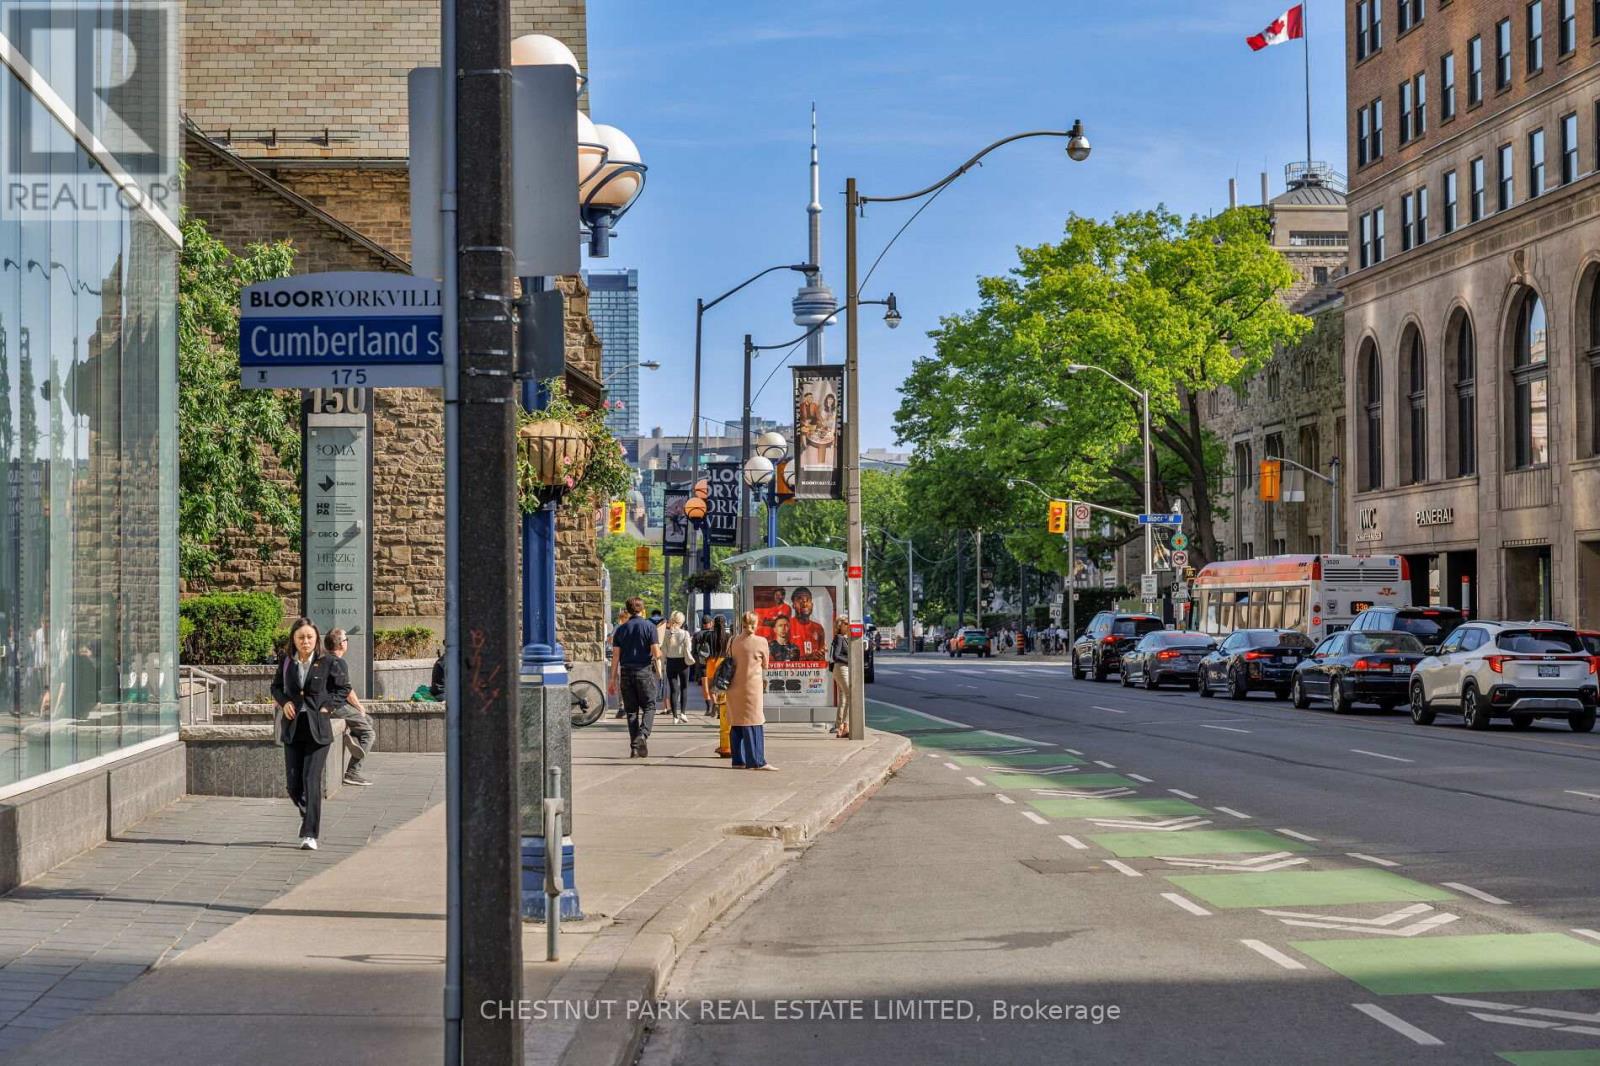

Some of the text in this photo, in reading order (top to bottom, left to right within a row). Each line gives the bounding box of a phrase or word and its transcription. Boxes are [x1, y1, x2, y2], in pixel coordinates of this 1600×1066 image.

[251, 325, 442, 357] Cumberland S
[331, 369, 367, 385] 175
[309, 387, 366, 414] 150
[1360, 507, 1377, 529] IWC
[317, 581, 353, 592] altera
[1051, 607, 1061, 616] 40
